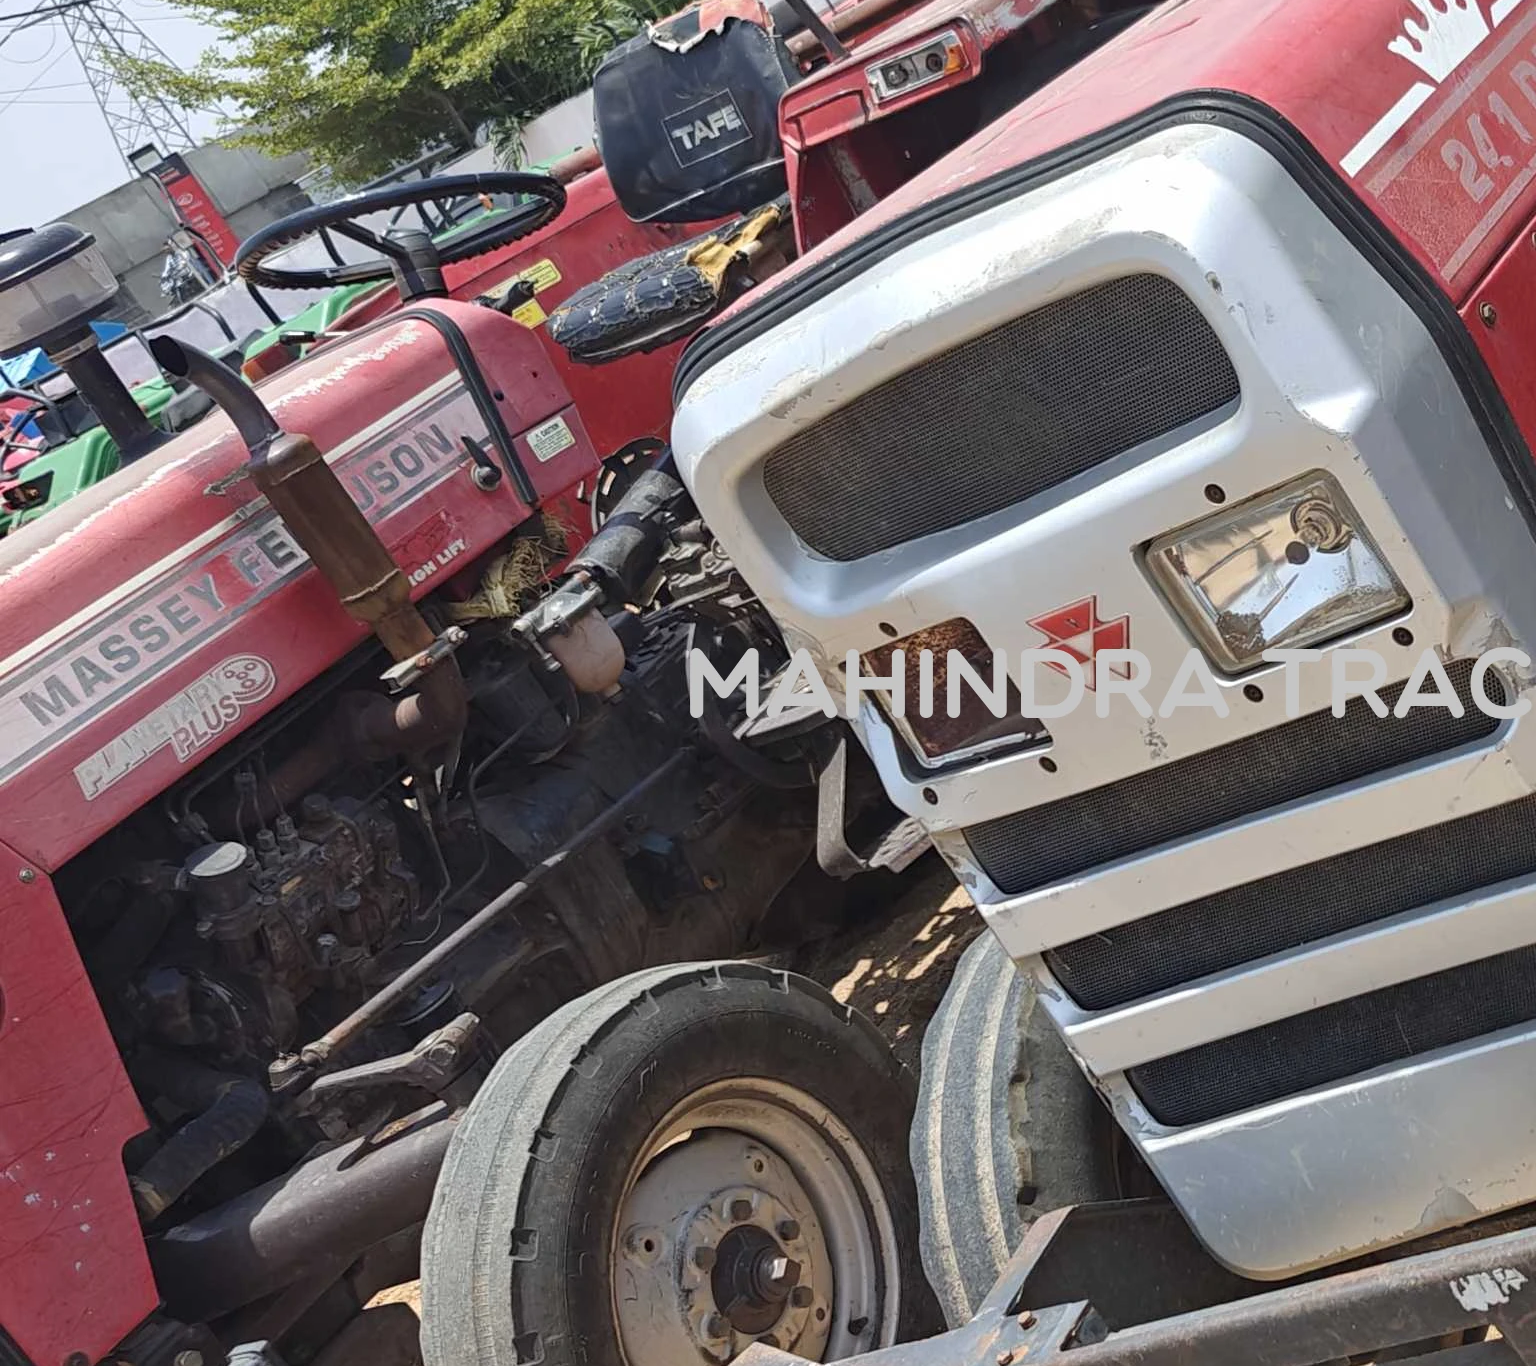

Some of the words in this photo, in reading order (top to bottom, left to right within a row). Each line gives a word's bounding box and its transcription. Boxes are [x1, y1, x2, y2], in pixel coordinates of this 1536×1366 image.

[671, 104, 741, 150] TAFE
[1440, 90, 1533, 204] 241
[436, 538, 467, 565] LIFT
[19, 572, 225, 727] MASSEY
[170, 691, 243, 764] PLUS
